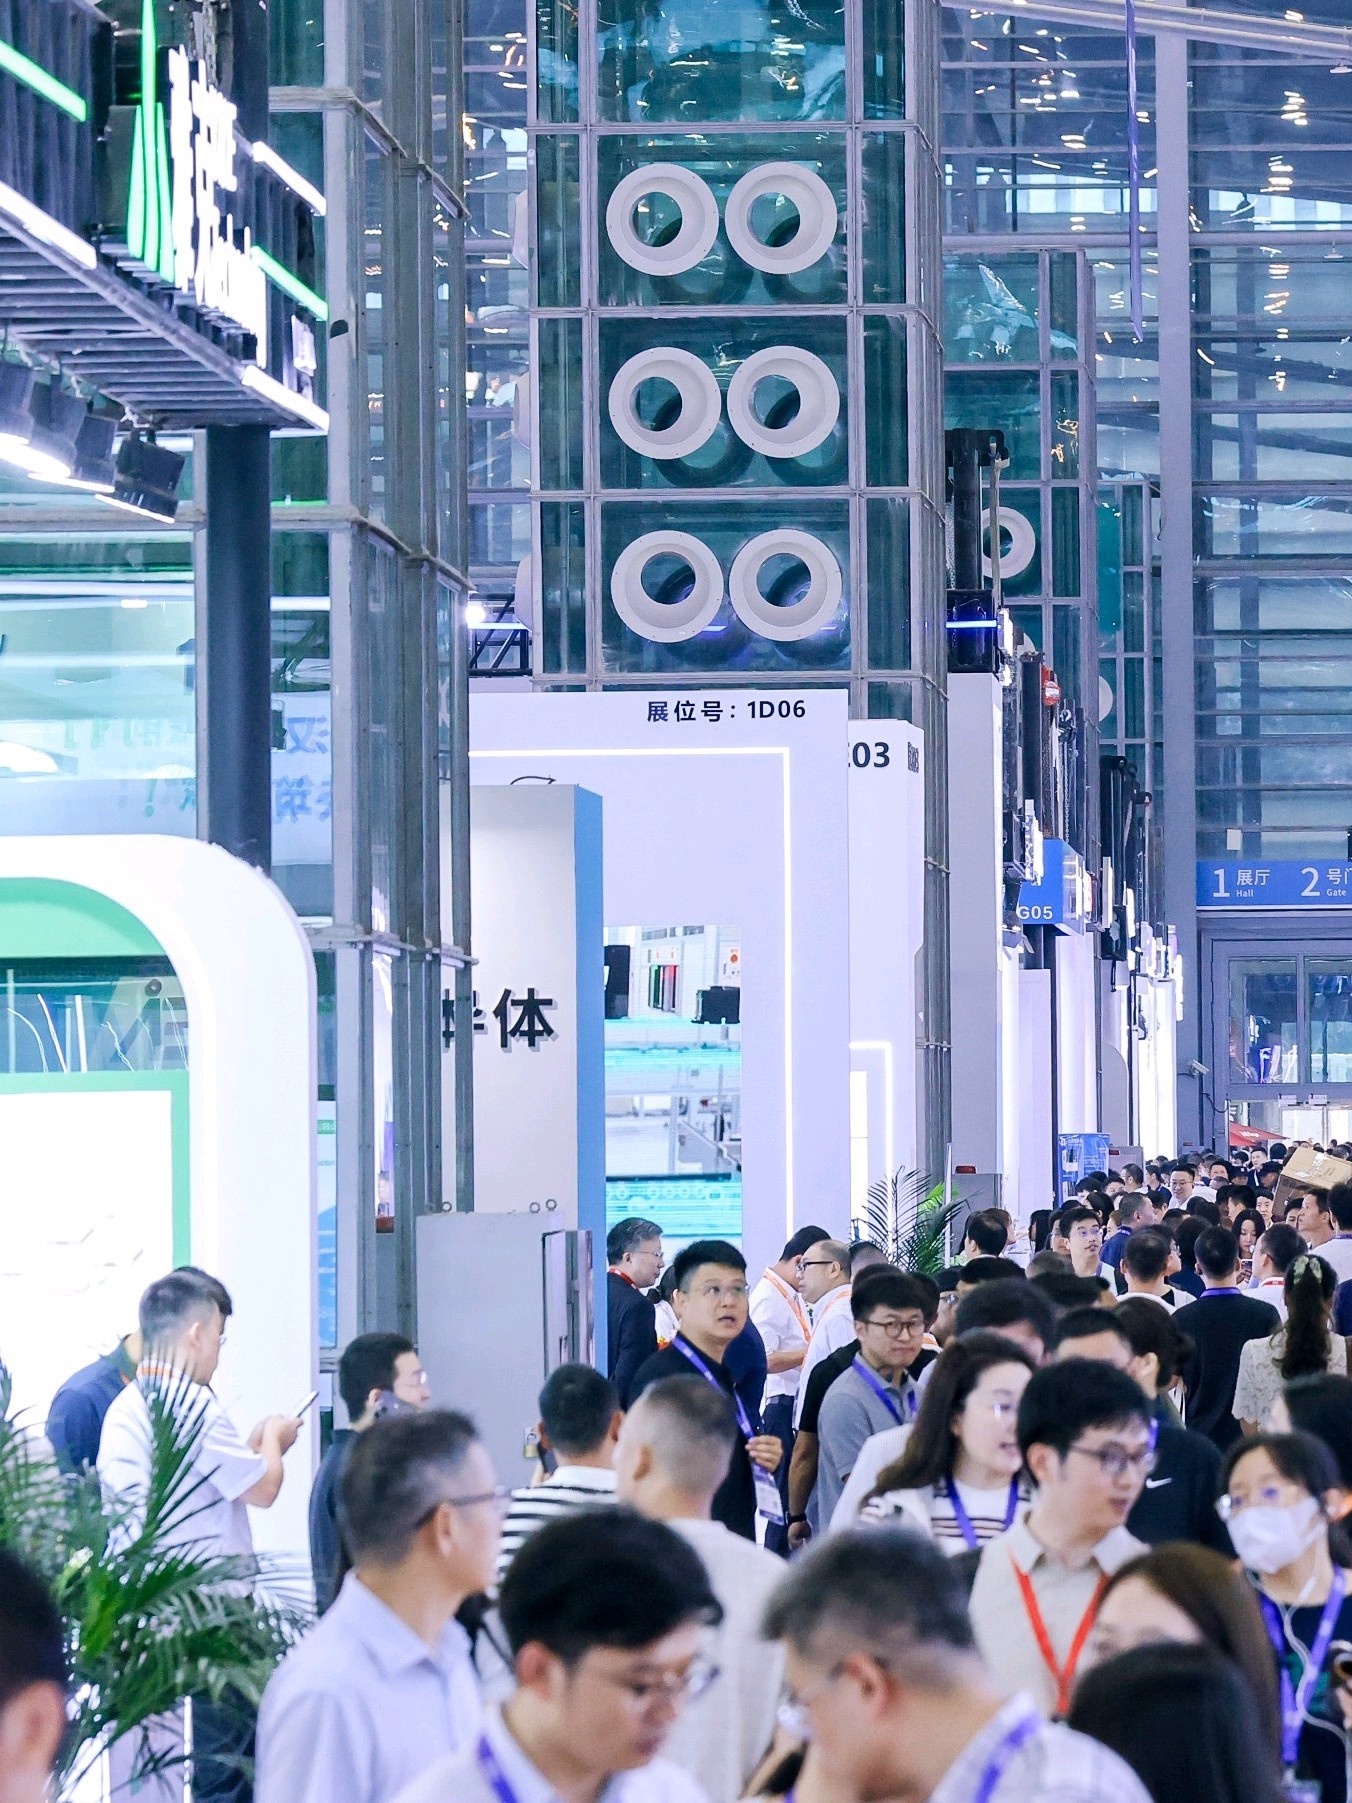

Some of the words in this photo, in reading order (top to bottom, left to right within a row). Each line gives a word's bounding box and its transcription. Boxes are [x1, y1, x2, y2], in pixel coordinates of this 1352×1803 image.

[848, 742, 890, 768] 03
[1213, 868, 1230, 898] 1
[1236, 869, 1271, 886] 展厅
[1301, 867, 1321, 897] 2
[1236, 889, 1254, 898] Hall
[1326, 888, 1347, 897] Gate
[473, 987, 555, 1049] 体
